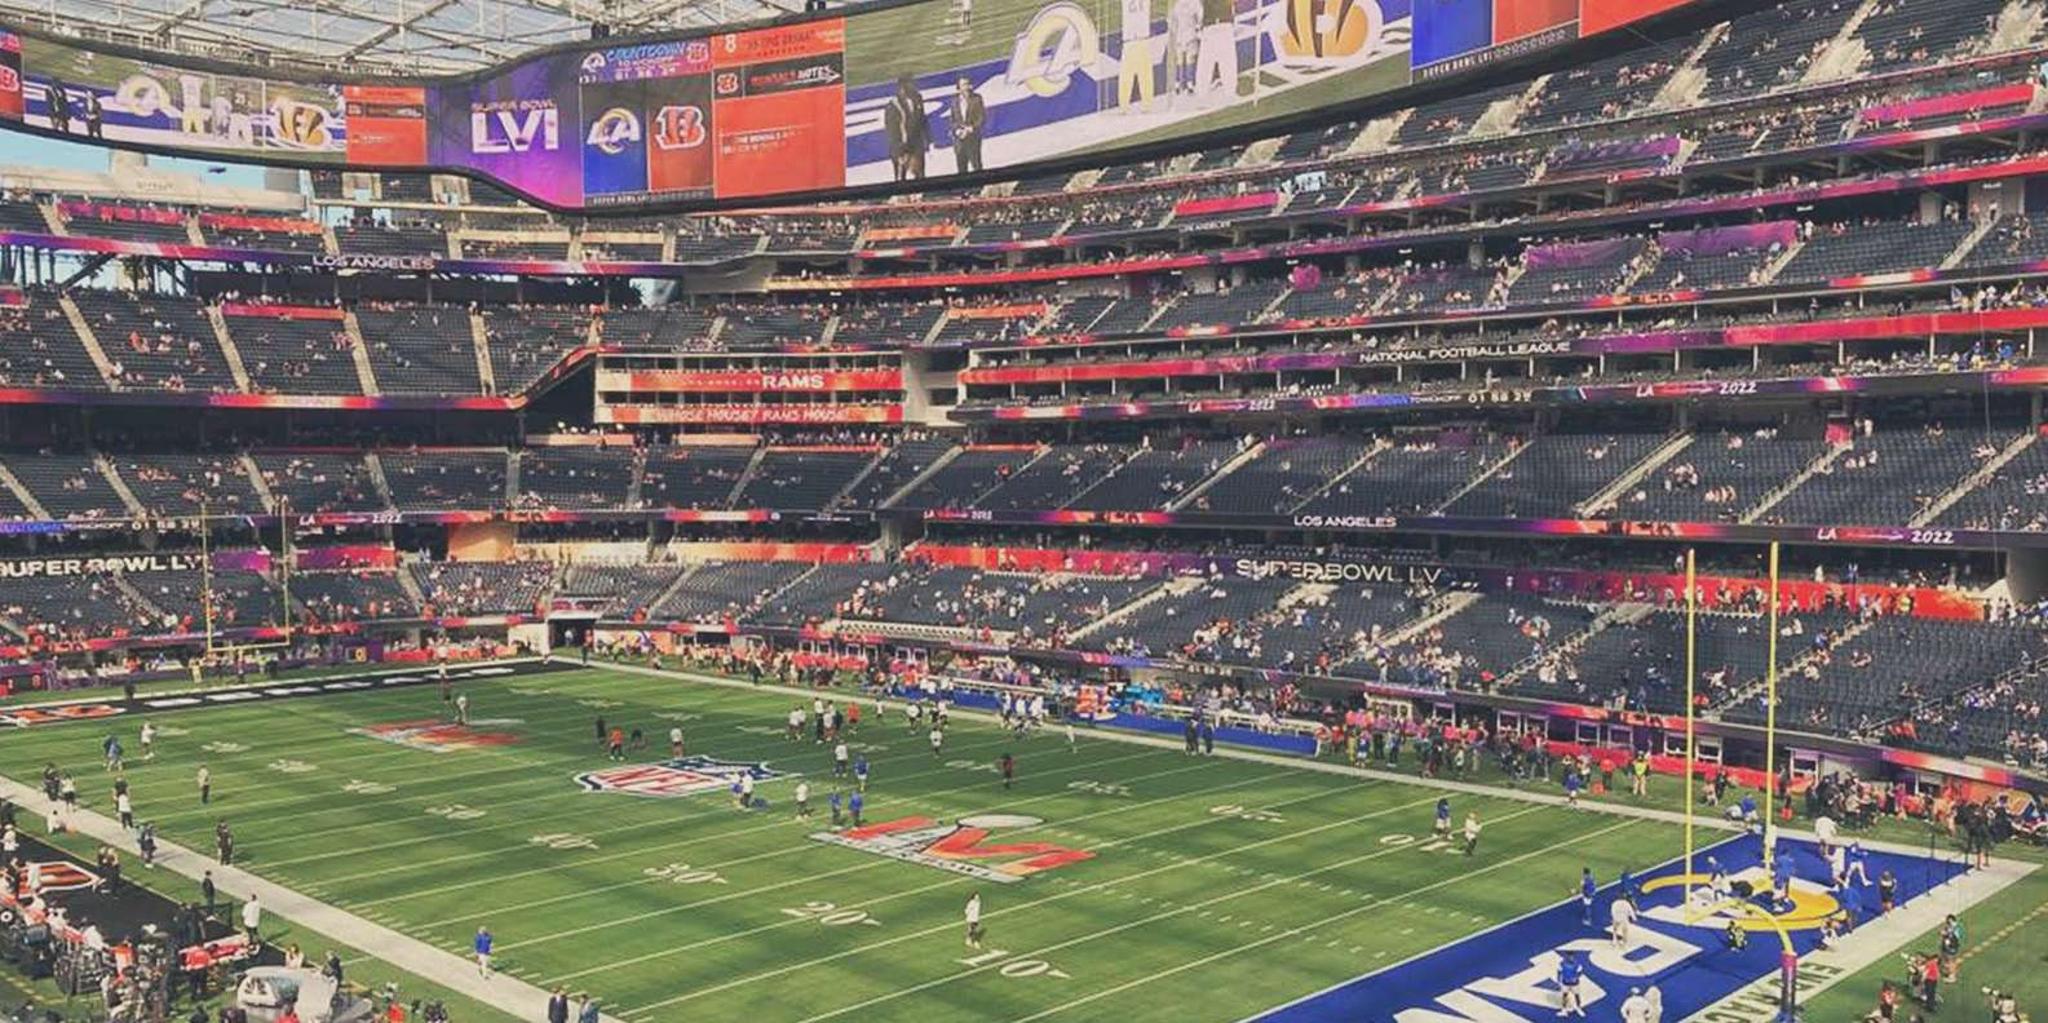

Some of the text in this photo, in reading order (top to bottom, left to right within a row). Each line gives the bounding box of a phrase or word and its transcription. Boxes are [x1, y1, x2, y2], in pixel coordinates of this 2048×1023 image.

[471, 109, 560, 154] LVI
[313, 254, 436, 271] LOS ANGELES
[1360, 341, 1571, 363] NATIONAL FOOTBALL LEAGUE
[761, 374, 825, 389] RAMS
[1636, 382, 1758, 398] LA 2022
[762, 410, 801, 422] RAMS
[1294, 516, 1397, 528] LOS ANGELES
[1818, 530, 1956, 544] LA 2022
[1236, 558, 1324, 581] SUPER
[1324, 563, 1404, 583] BOWL
[953, 948, 1072, 979] 10
